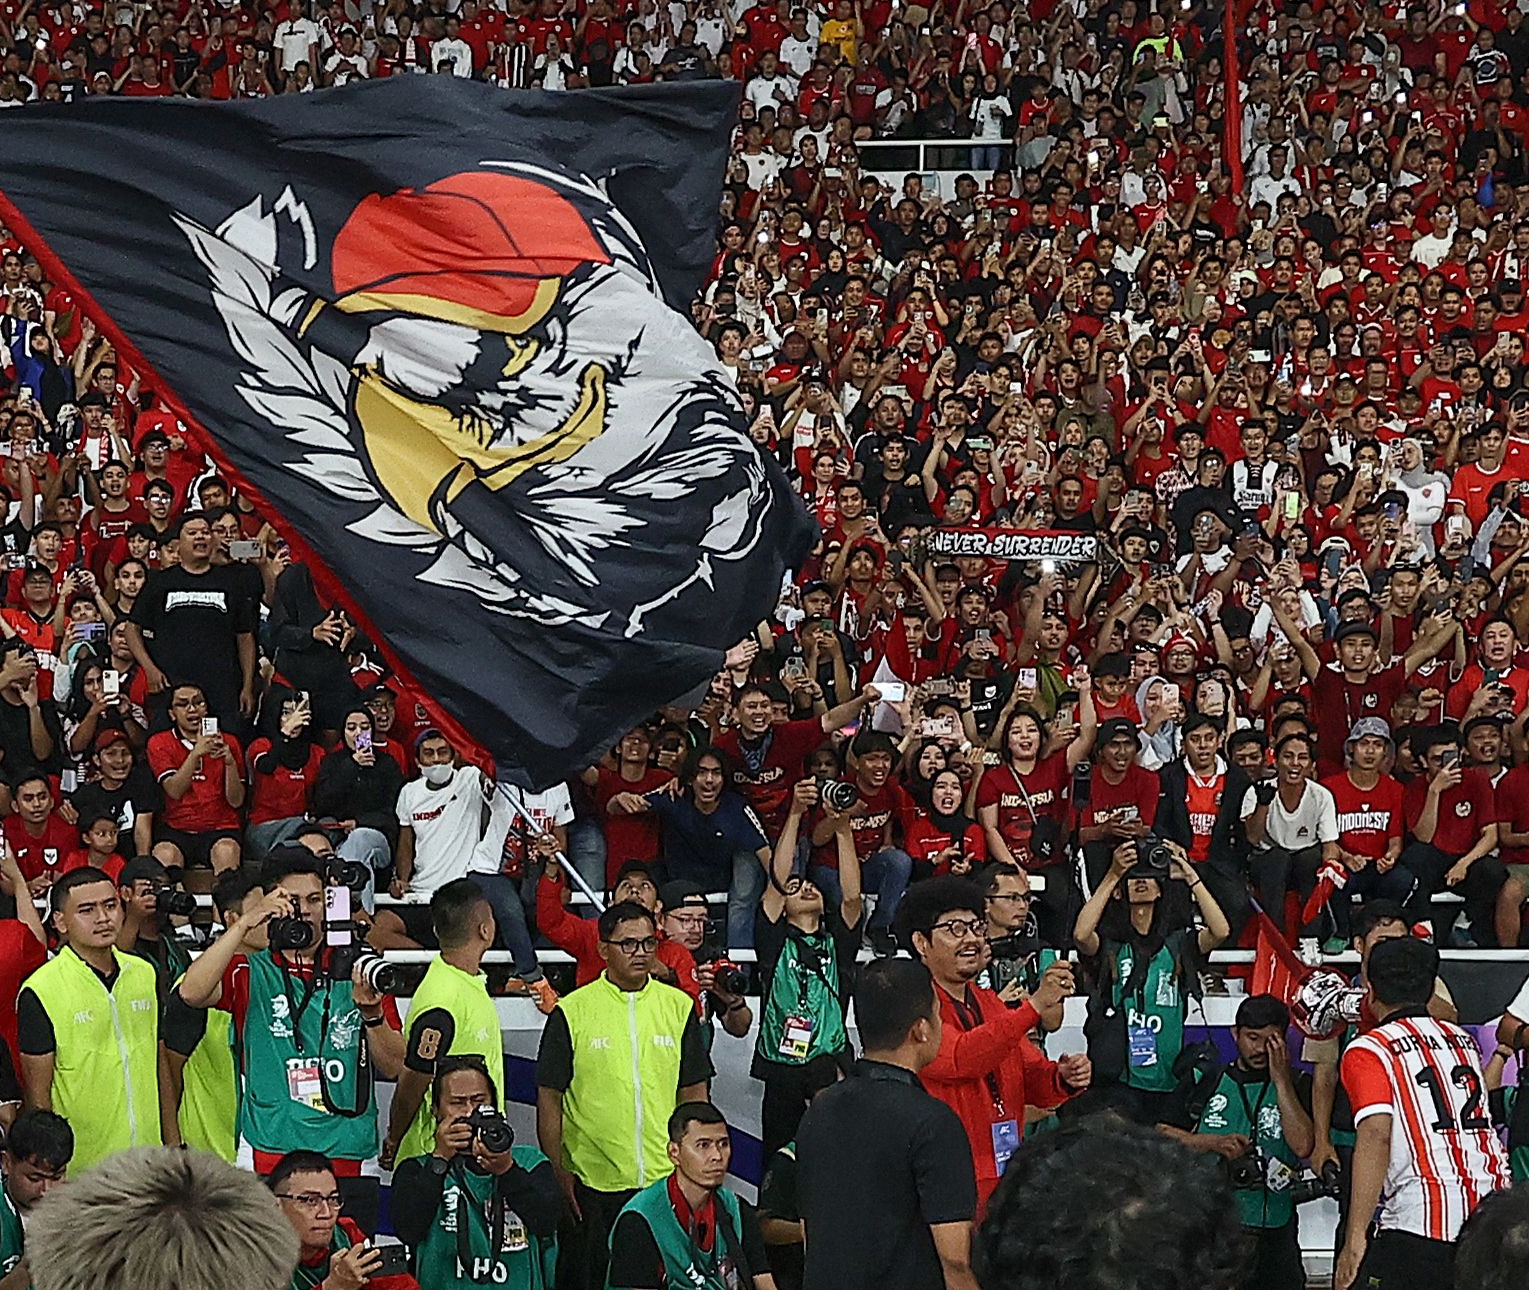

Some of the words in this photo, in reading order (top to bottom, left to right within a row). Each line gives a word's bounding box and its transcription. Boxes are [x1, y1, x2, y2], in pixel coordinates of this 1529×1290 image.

[935, 531, 988, 553] NEVER
[992, 534, 1097, 557] SURRENDER
[418, 1027, 442, 1060] 8
[1414, 1065, 1490, 1130] 12
